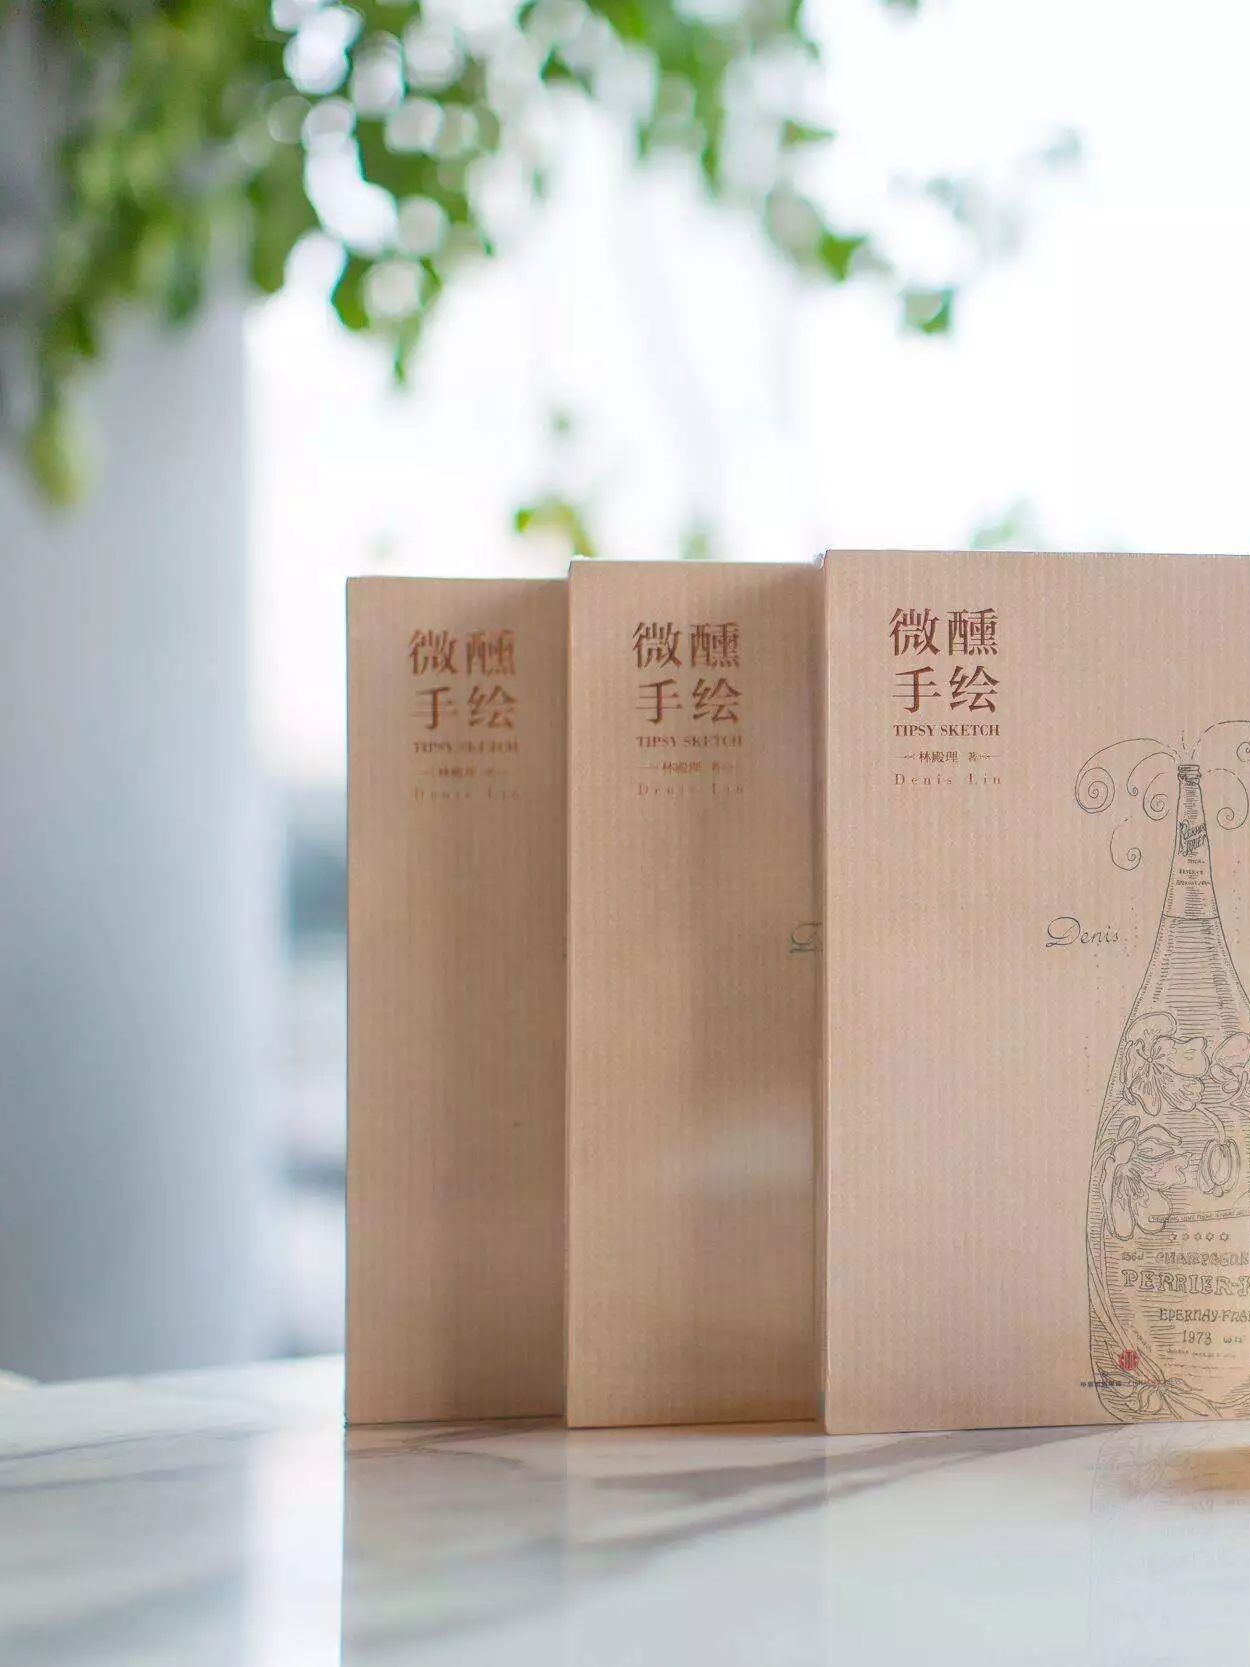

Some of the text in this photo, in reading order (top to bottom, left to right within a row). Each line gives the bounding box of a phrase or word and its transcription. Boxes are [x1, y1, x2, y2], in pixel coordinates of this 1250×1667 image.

[633, 622, 741, 668] 微醺
[889, 608, 999, 656] 微醺
[411, 685, 517, 730] 手绘
[636, 678, 743, 724] 手绘
[892, 665, 1000, 713] 手绘
[637, 736, 677, 748] TIPSY
[894, 724, 1000, 737] TIPSY SKETCH
[895, 773, 1000, 785] Denis Lin
[1045, 916, 1120, 947] Denis
